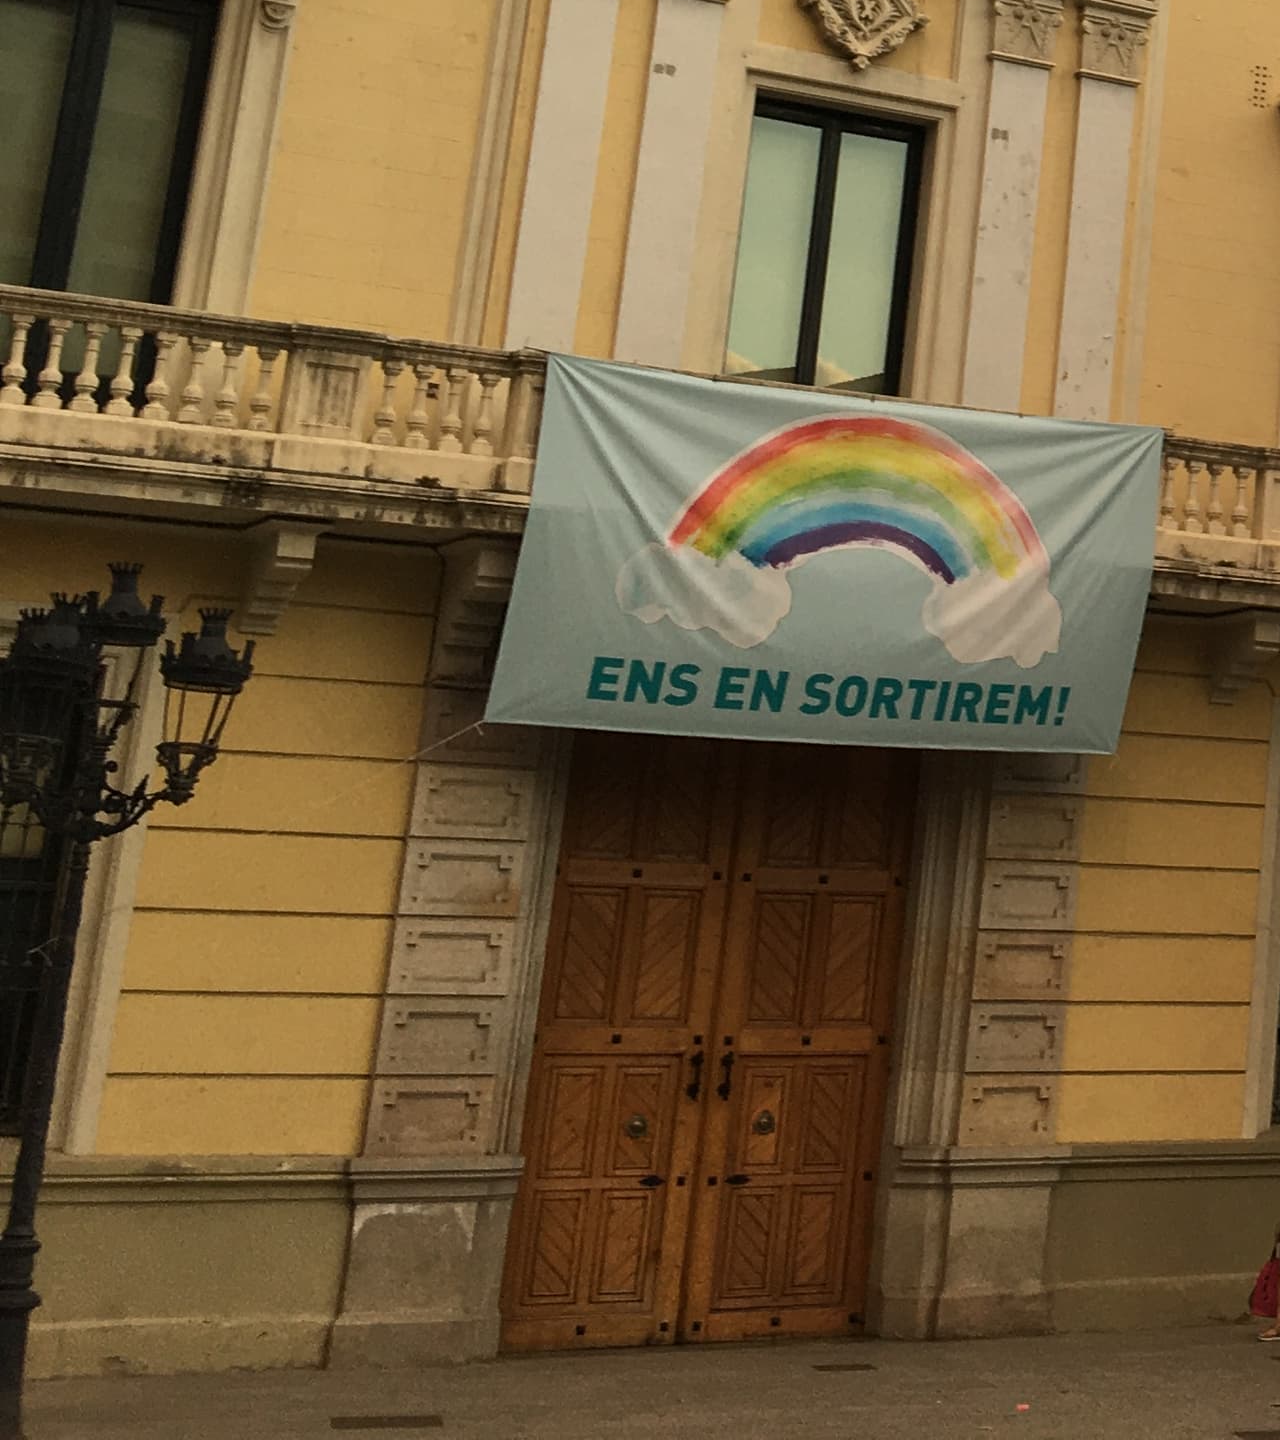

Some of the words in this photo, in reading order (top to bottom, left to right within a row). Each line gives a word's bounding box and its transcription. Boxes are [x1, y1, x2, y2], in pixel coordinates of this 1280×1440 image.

[587, 656, 703, 706] ENS
[713, 666, 790, 713] EN
[799, 673, 1072, 726] SORTIREM!
